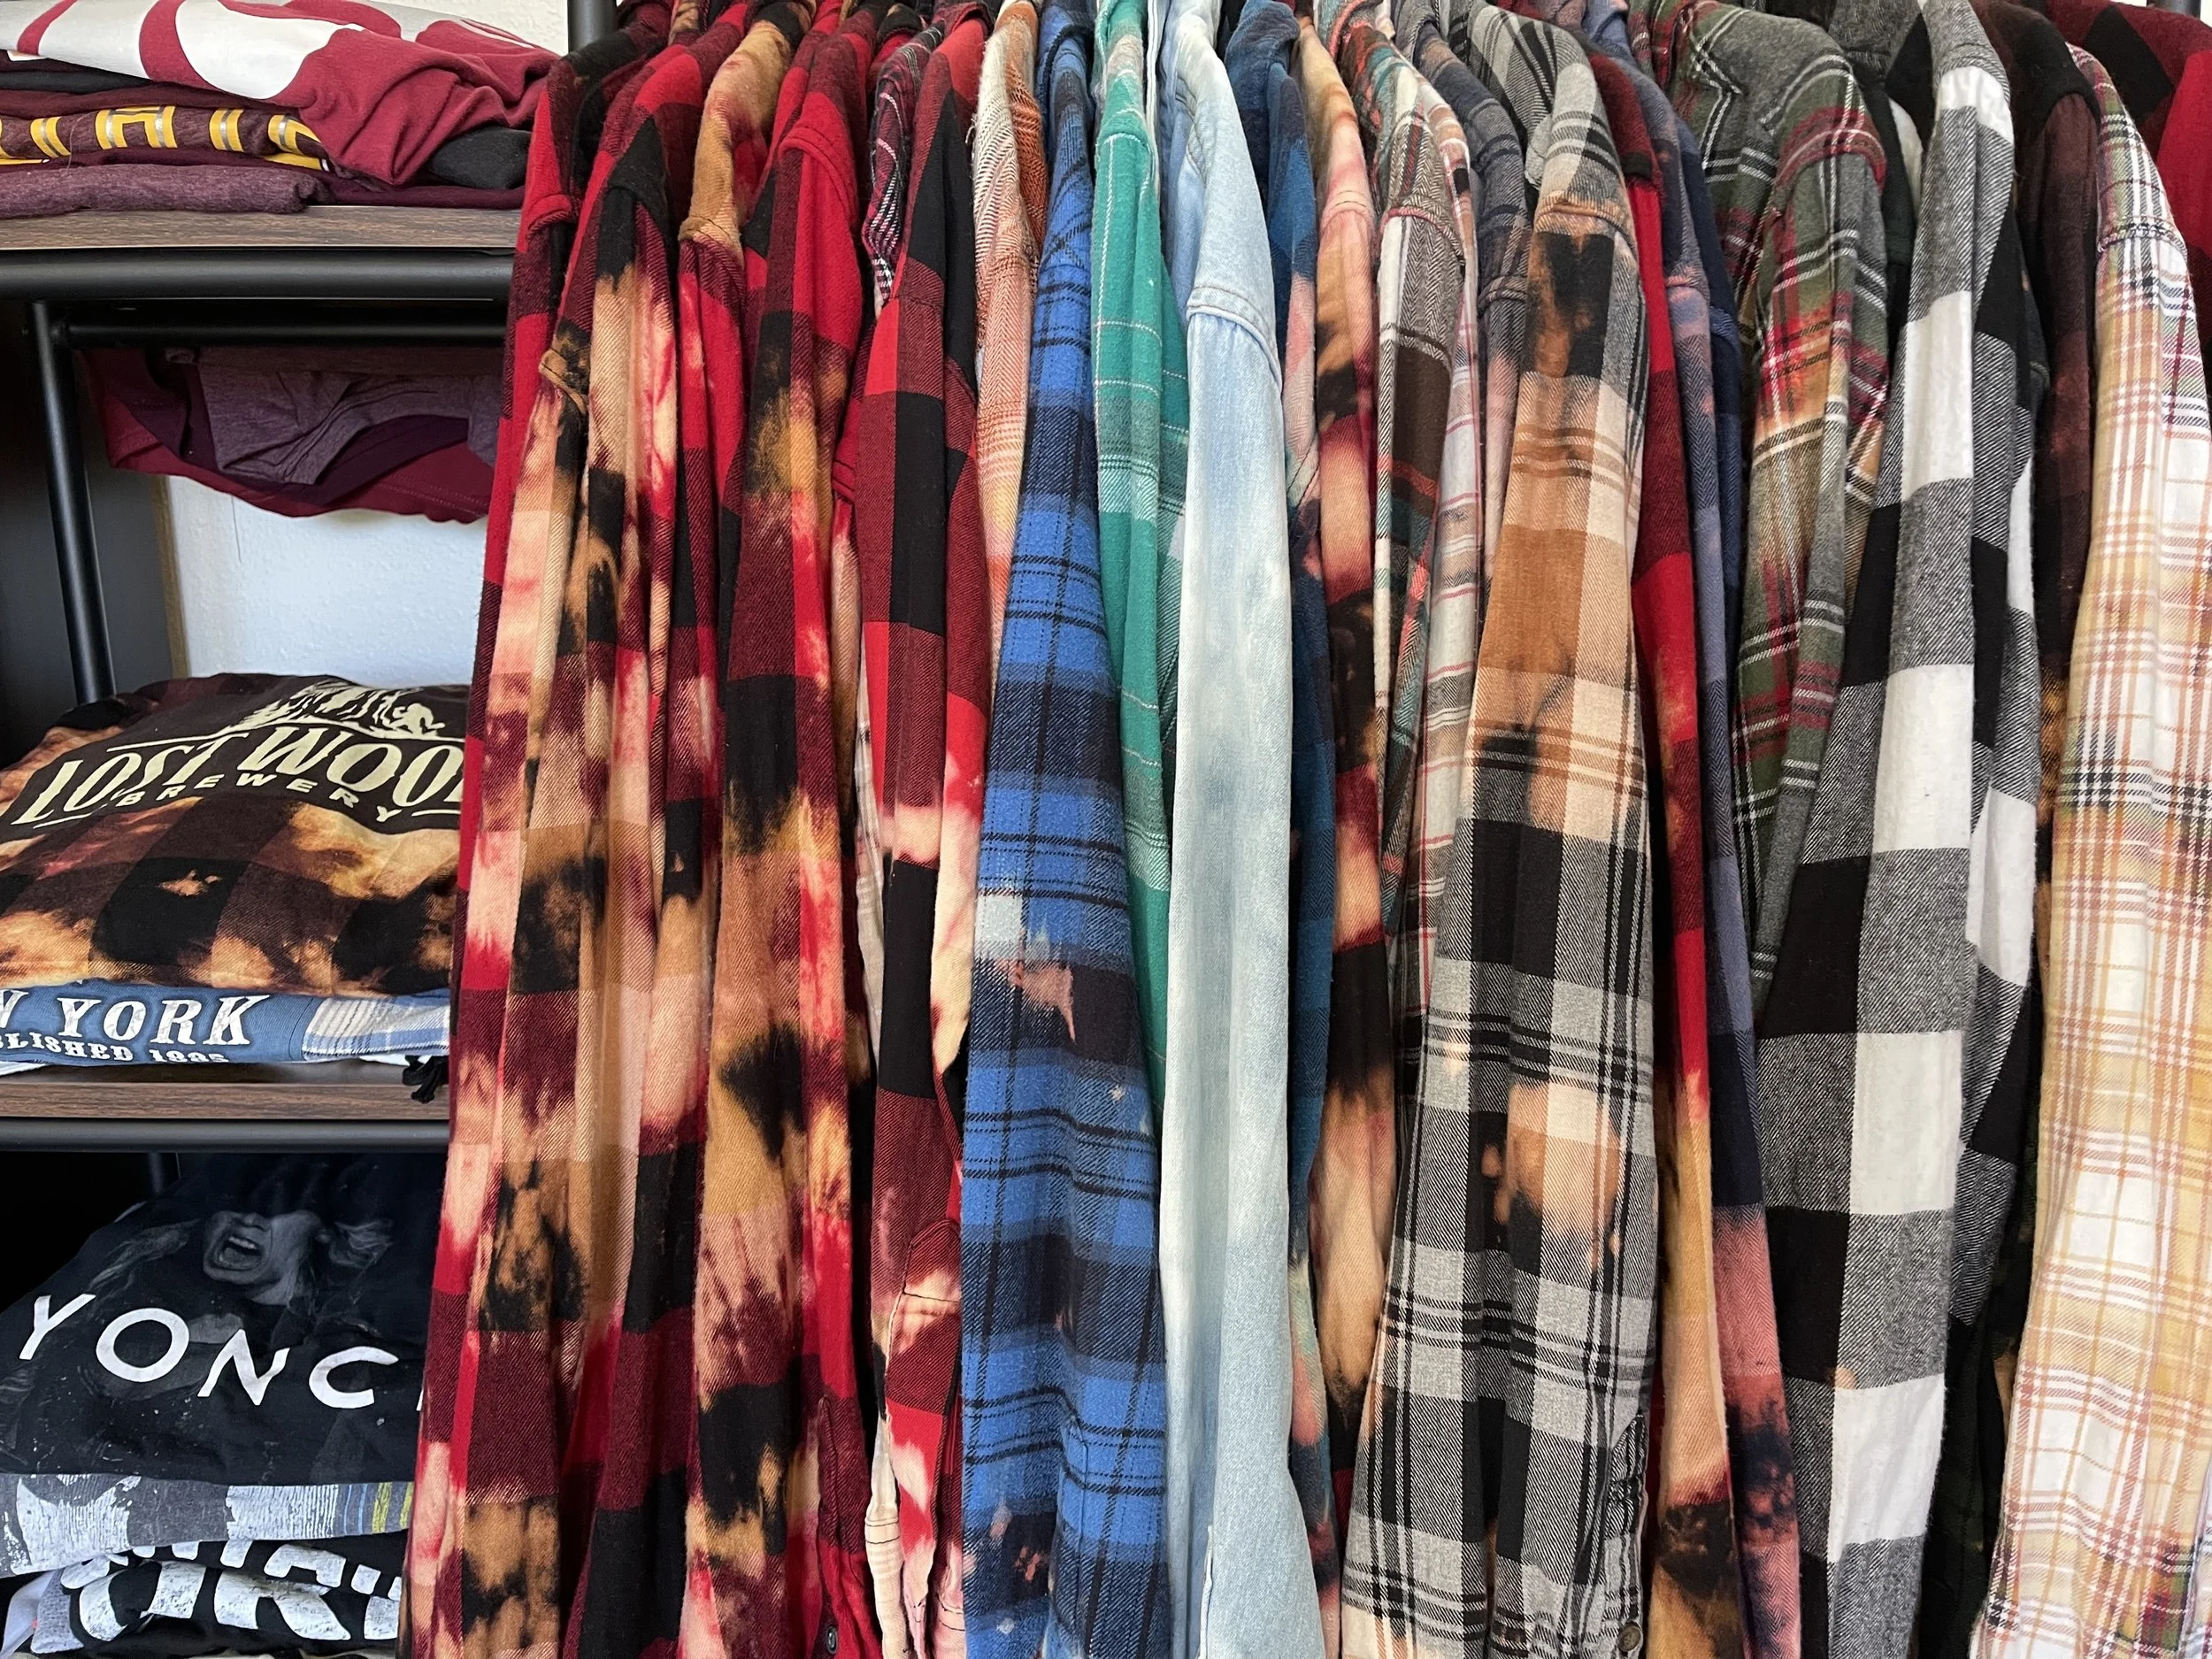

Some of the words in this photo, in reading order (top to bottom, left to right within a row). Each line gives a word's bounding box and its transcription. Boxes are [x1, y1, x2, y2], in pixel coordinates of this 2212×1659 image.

[11, 733, 249, 825] LOST
[238, 726, 465, 807] WOO
[115, 772, 403, 823] BREWERY
[57, 995, 270, 1046] YORK
[0, 1032, 134, 1061] LISHED
[19, 1293, 425, 1411] YONC
